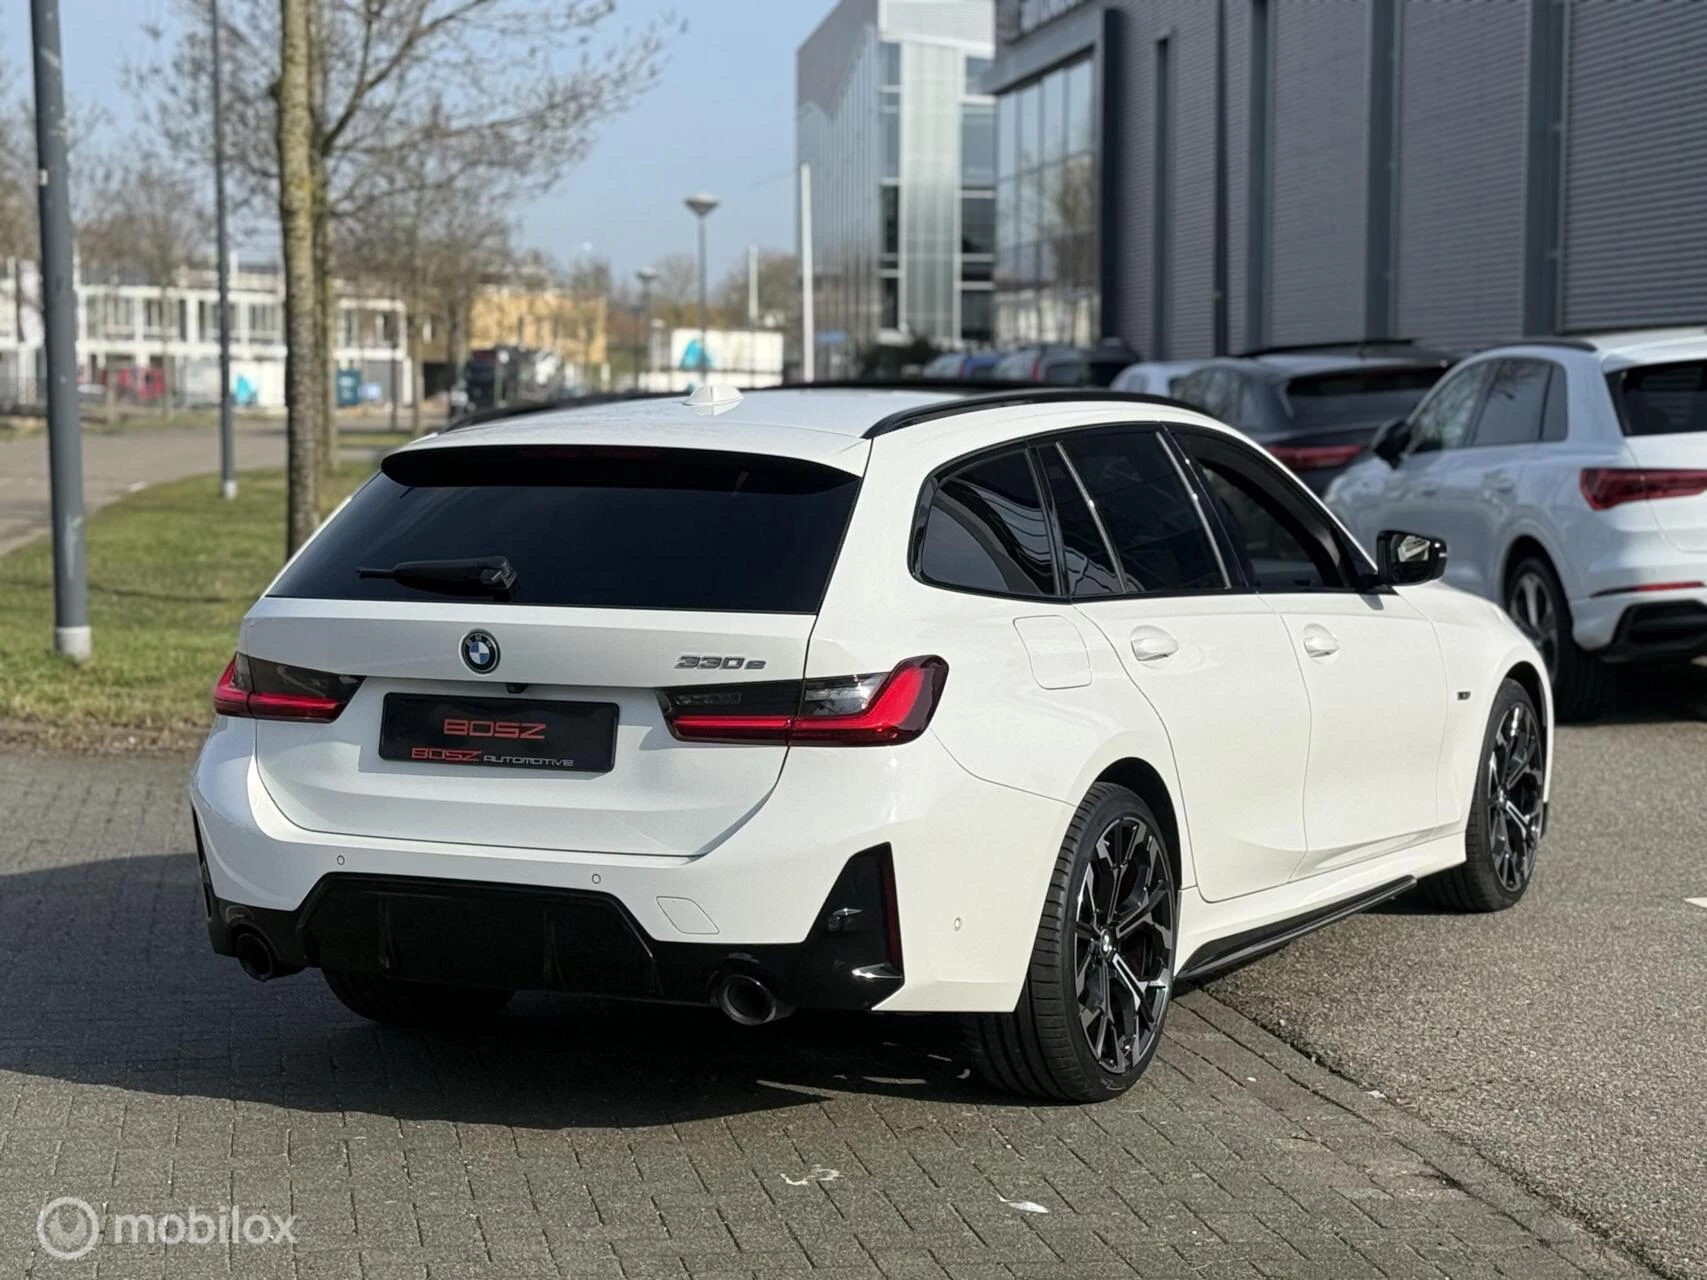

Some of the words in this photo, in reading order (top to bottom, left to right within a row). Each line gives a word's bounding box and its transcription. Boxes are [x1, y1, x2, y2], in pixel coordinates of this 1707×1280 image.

[443, 719, 547, 740] BOSZ
[411, 747, 482, 762] BOSZ
[483, 755, 575, 767] AUTOMOTIVE
